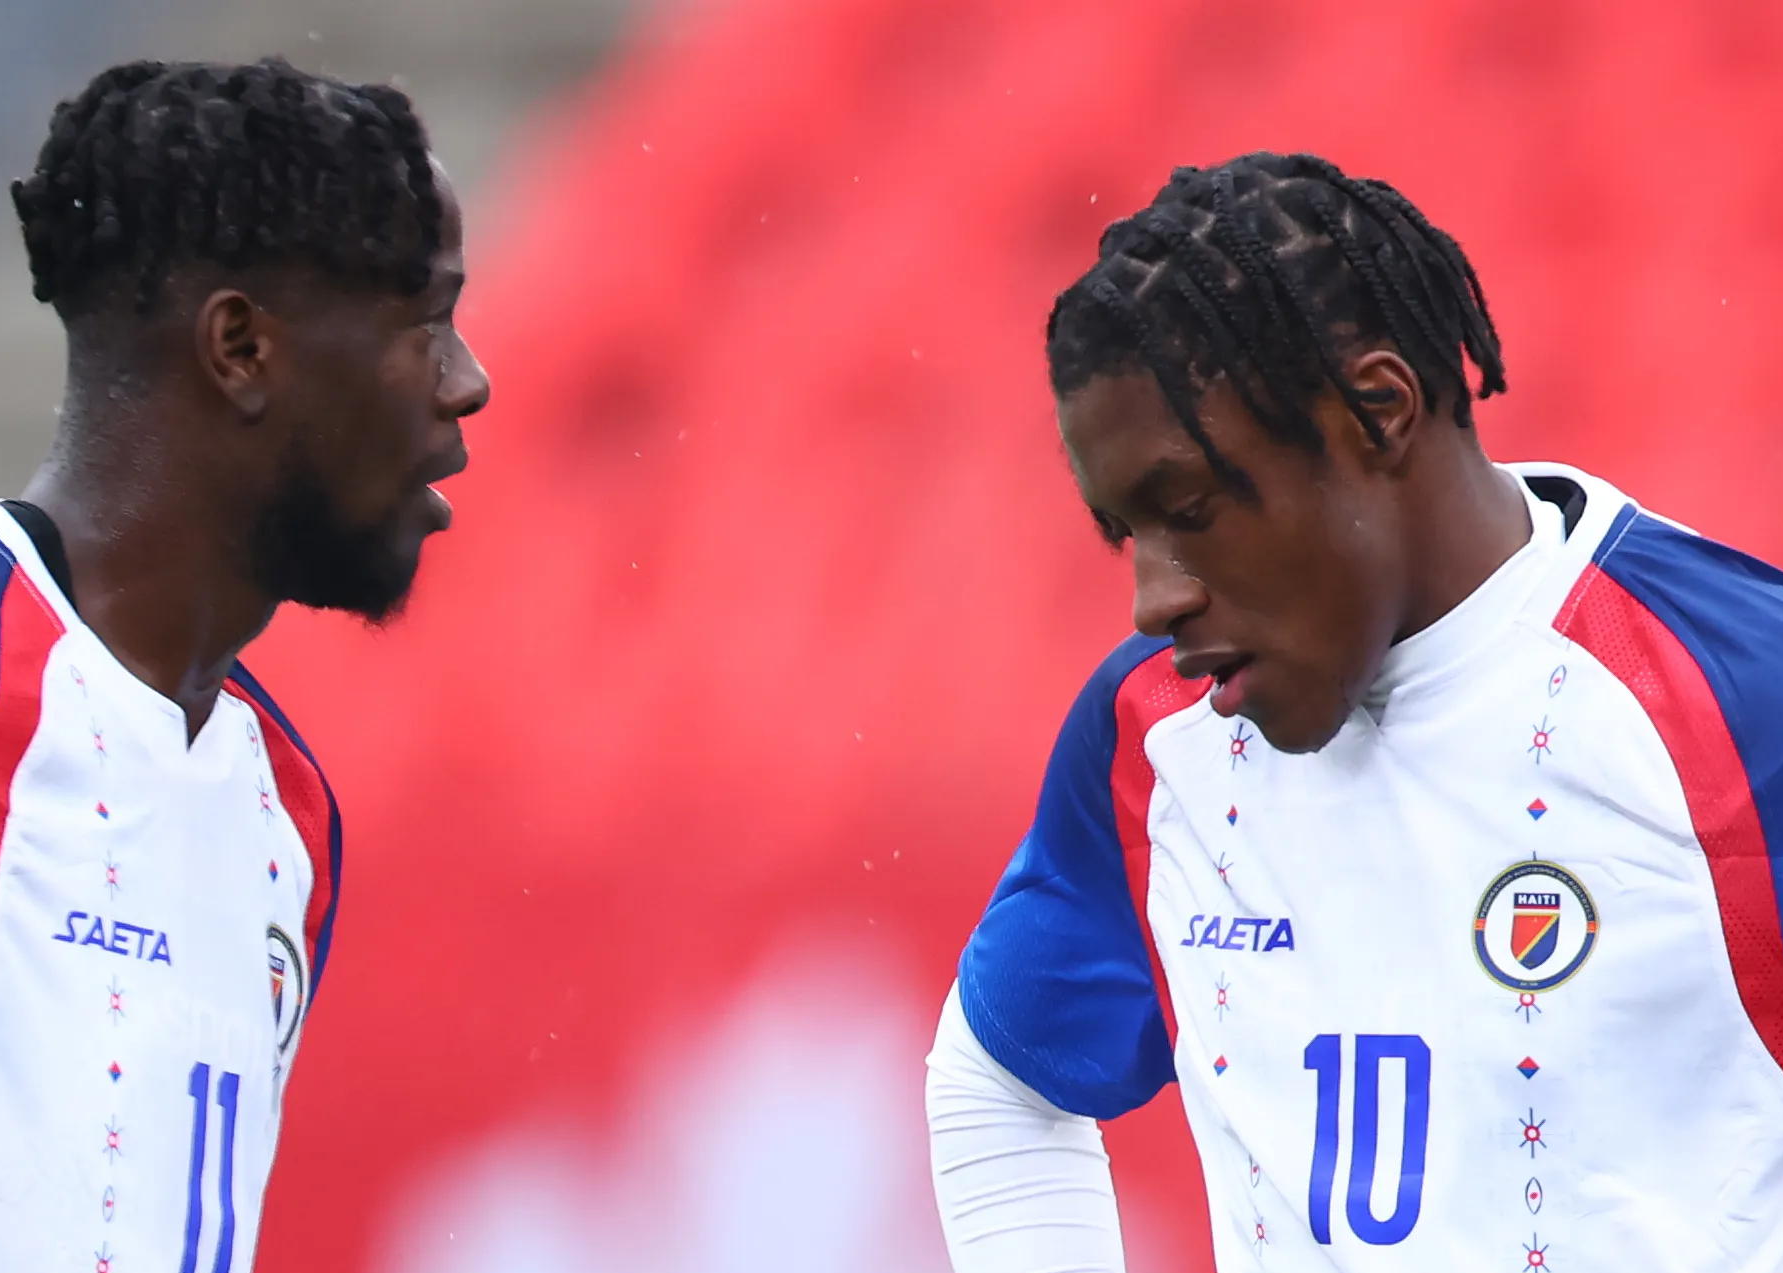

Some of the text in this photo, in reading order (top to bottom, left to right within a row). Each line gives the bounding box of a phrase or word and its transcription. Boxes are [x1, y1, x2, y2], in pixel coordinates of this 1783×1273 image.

[1518, 894, 1556, 905] HAITI
[52, 911, 172, 966] SAETA
[1180, 914, 1295, 951] SAETA
[1303, 1033, 1431, 1245] 10
